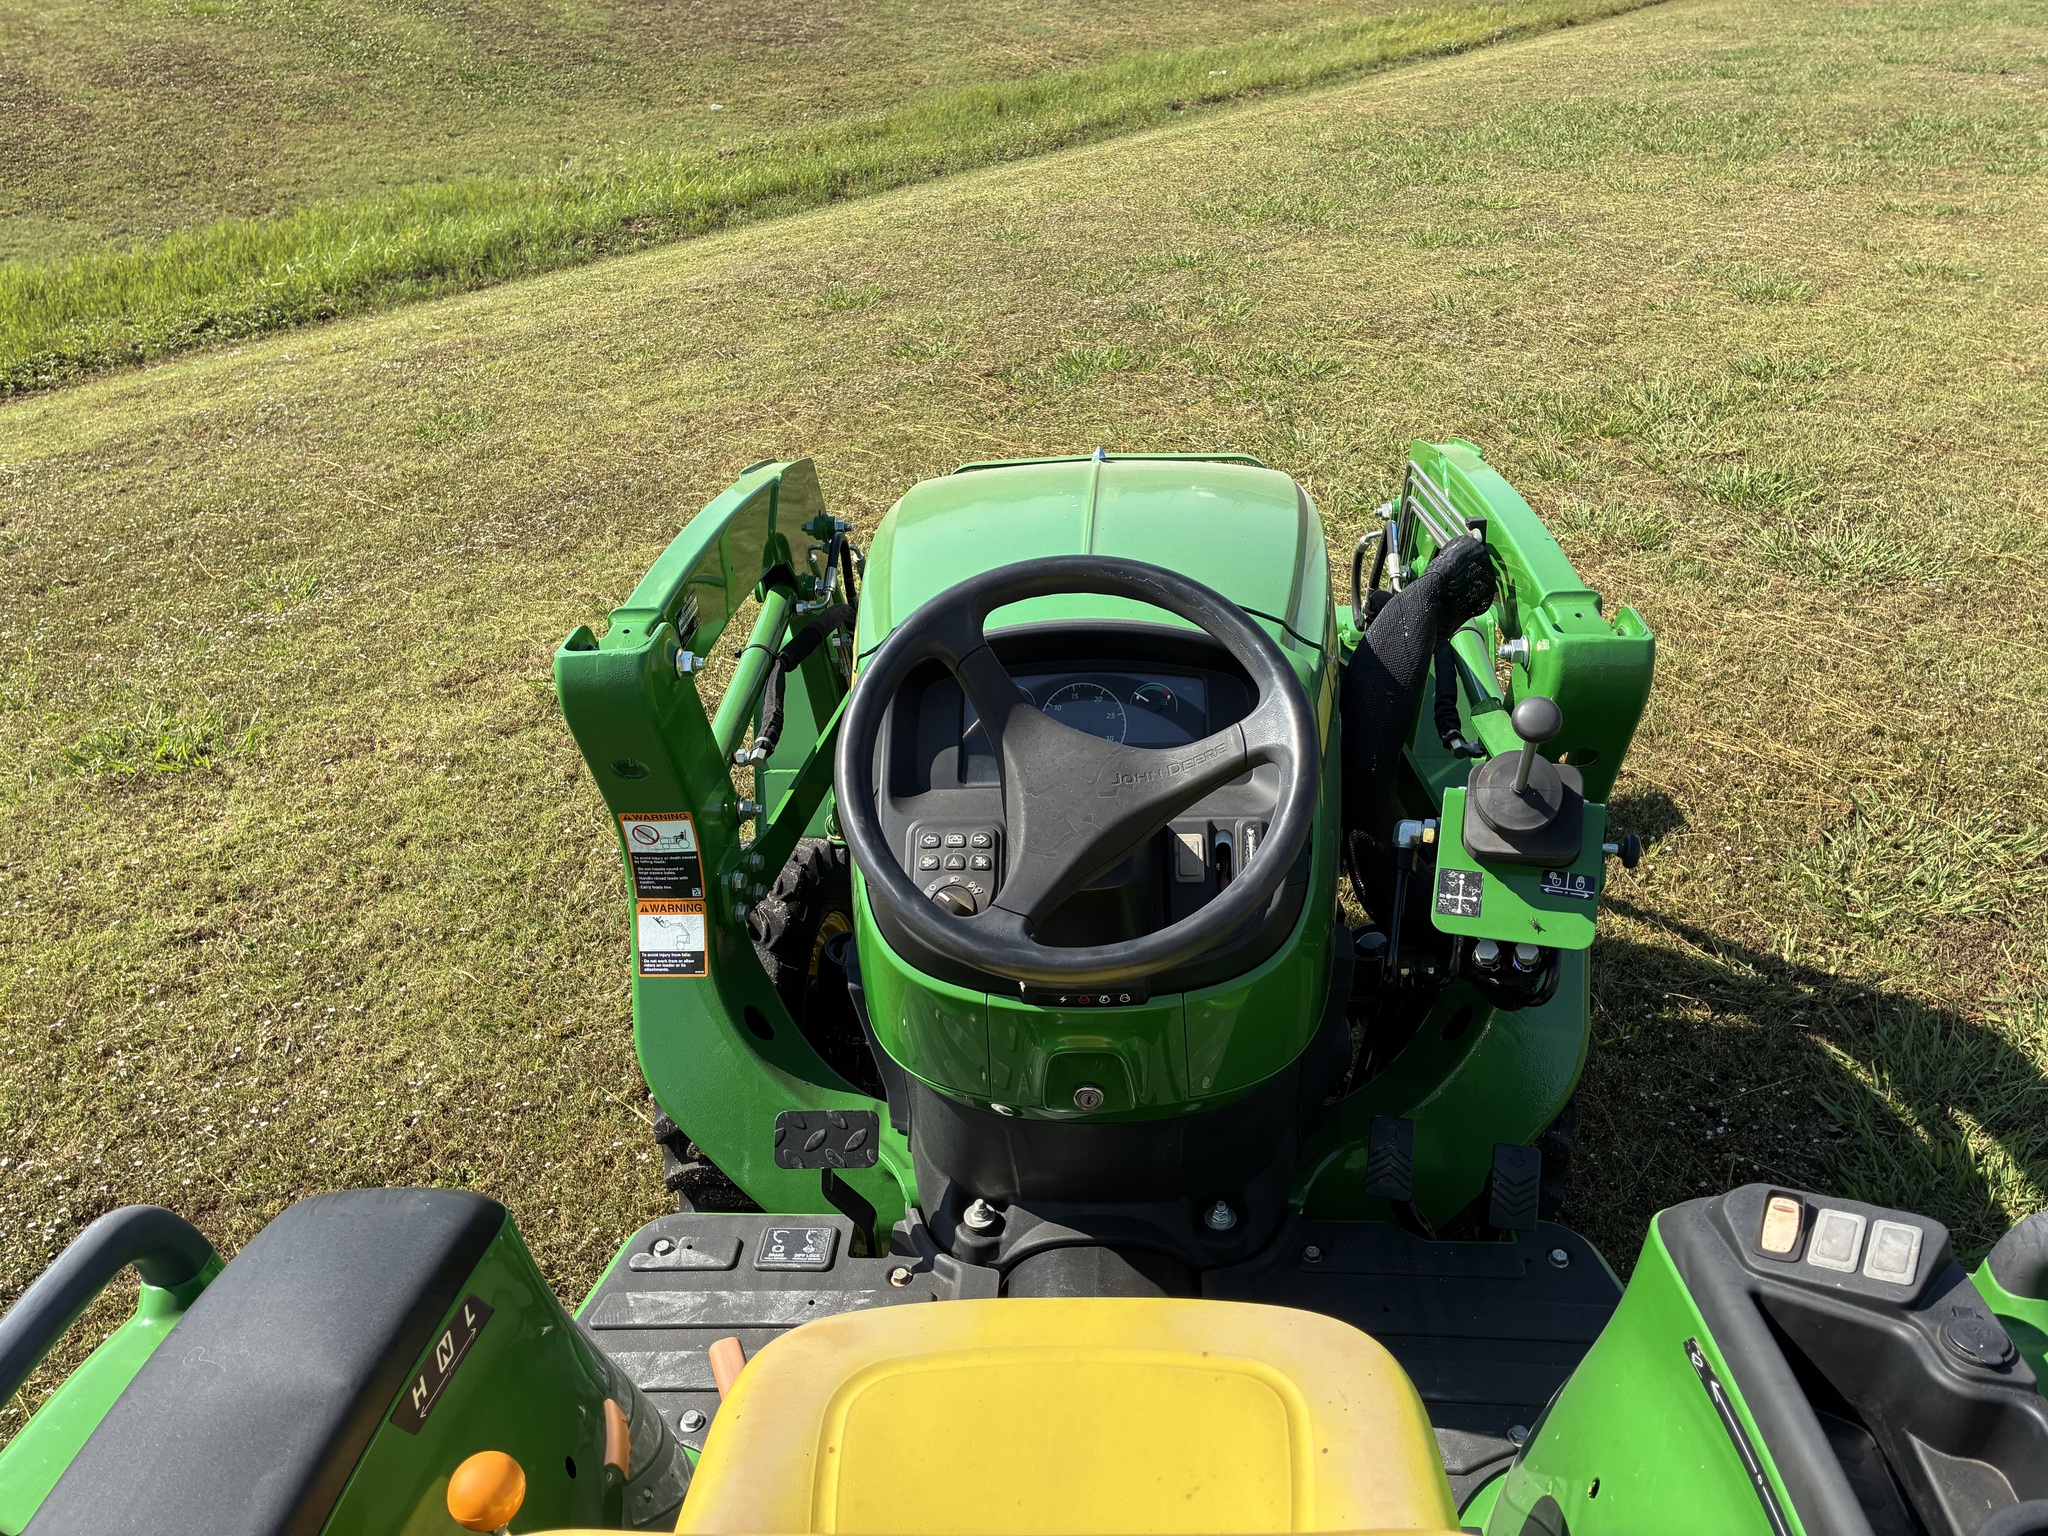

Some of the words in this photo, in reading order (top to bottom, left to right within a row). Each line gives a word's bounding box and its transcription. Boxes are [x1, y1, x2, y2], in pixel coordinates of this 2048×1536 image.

[1111, 768, 1163, 786] JOHN
[1167, 742, 1227, 776] DEERE
[650, 904, 702, 912] WARNING
[412, 1374, 428, 1410] H
[464, 1303, 476, 1328] L
